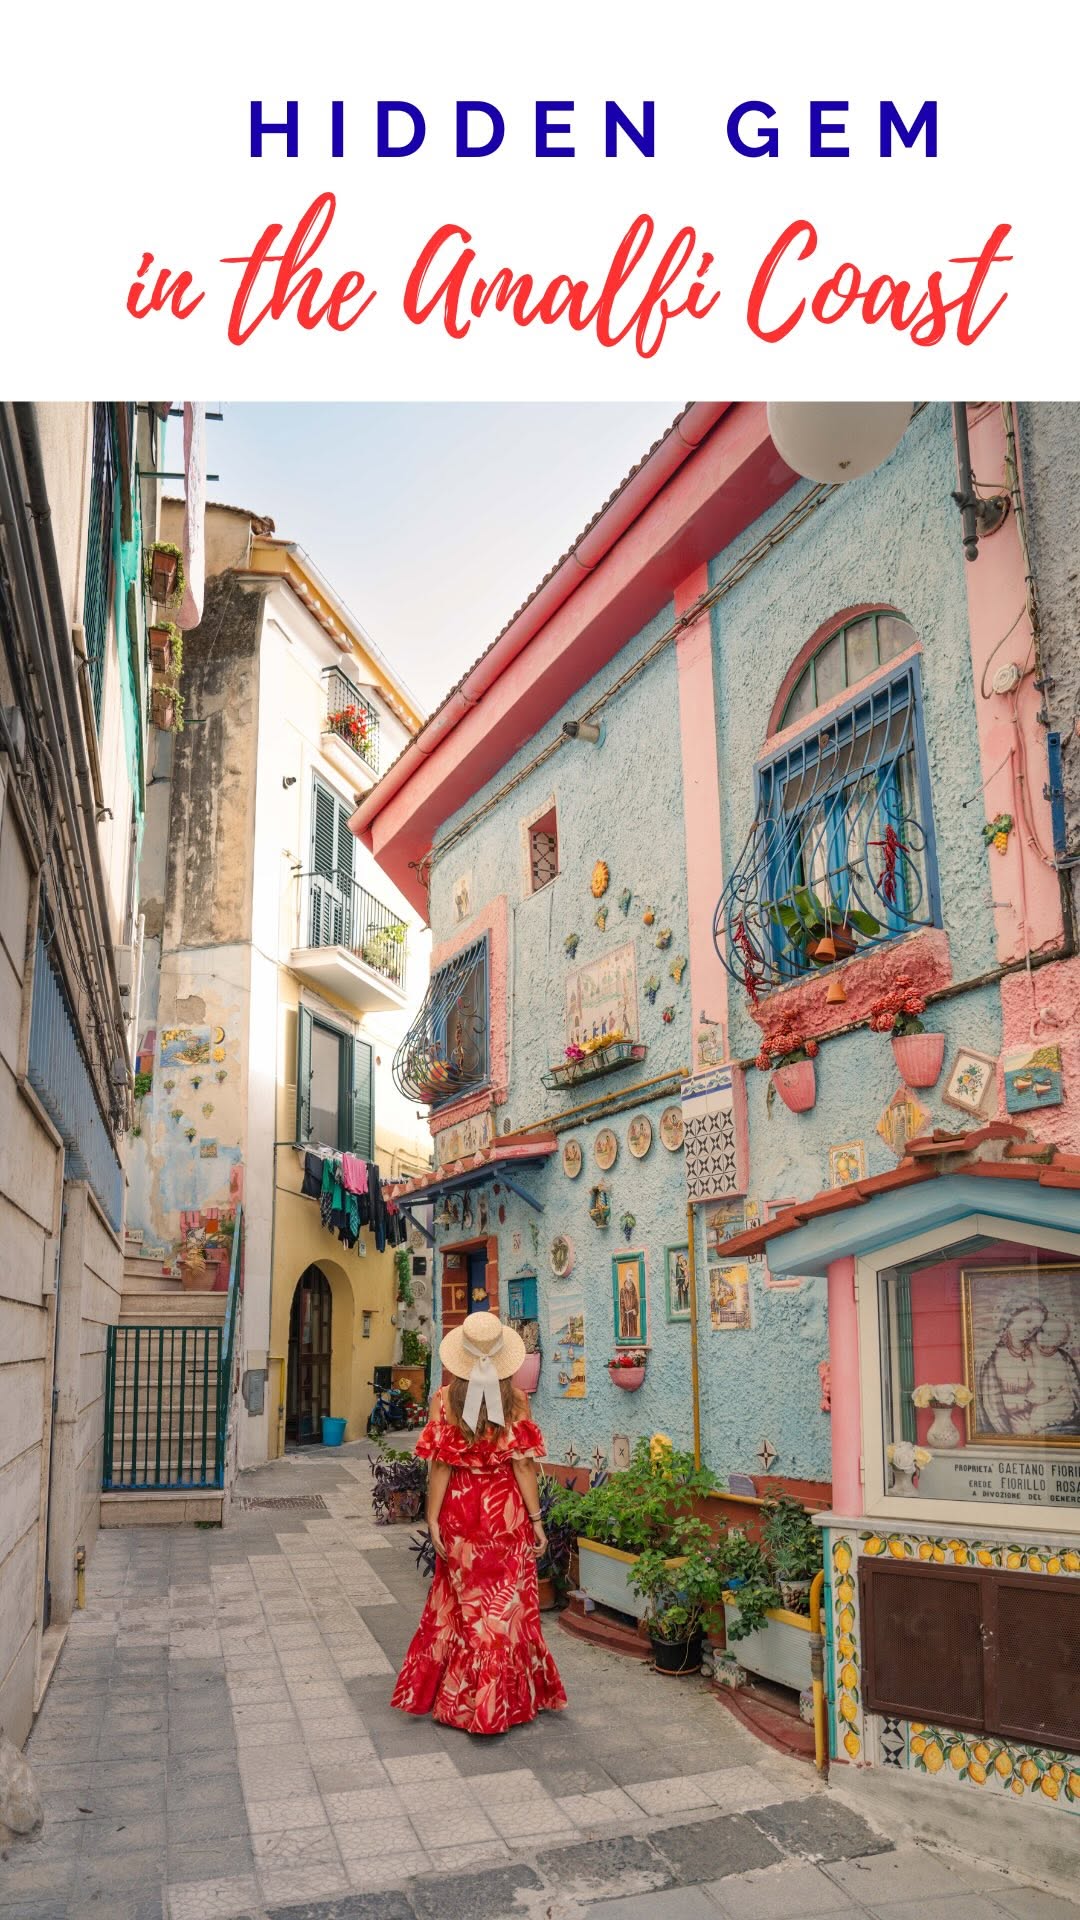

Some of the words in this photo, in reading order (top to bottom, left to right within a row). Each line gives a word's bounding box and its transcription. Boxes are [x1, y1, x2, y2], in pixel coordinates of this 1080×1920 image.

[998, 1462, 1044, 1476] GAETANO
[968, 1480, 992, 1489] EREDE
[1001, 1477, 1046, 1491] FIORILLO
[1028, 1493, 1042, 1501] DEL
